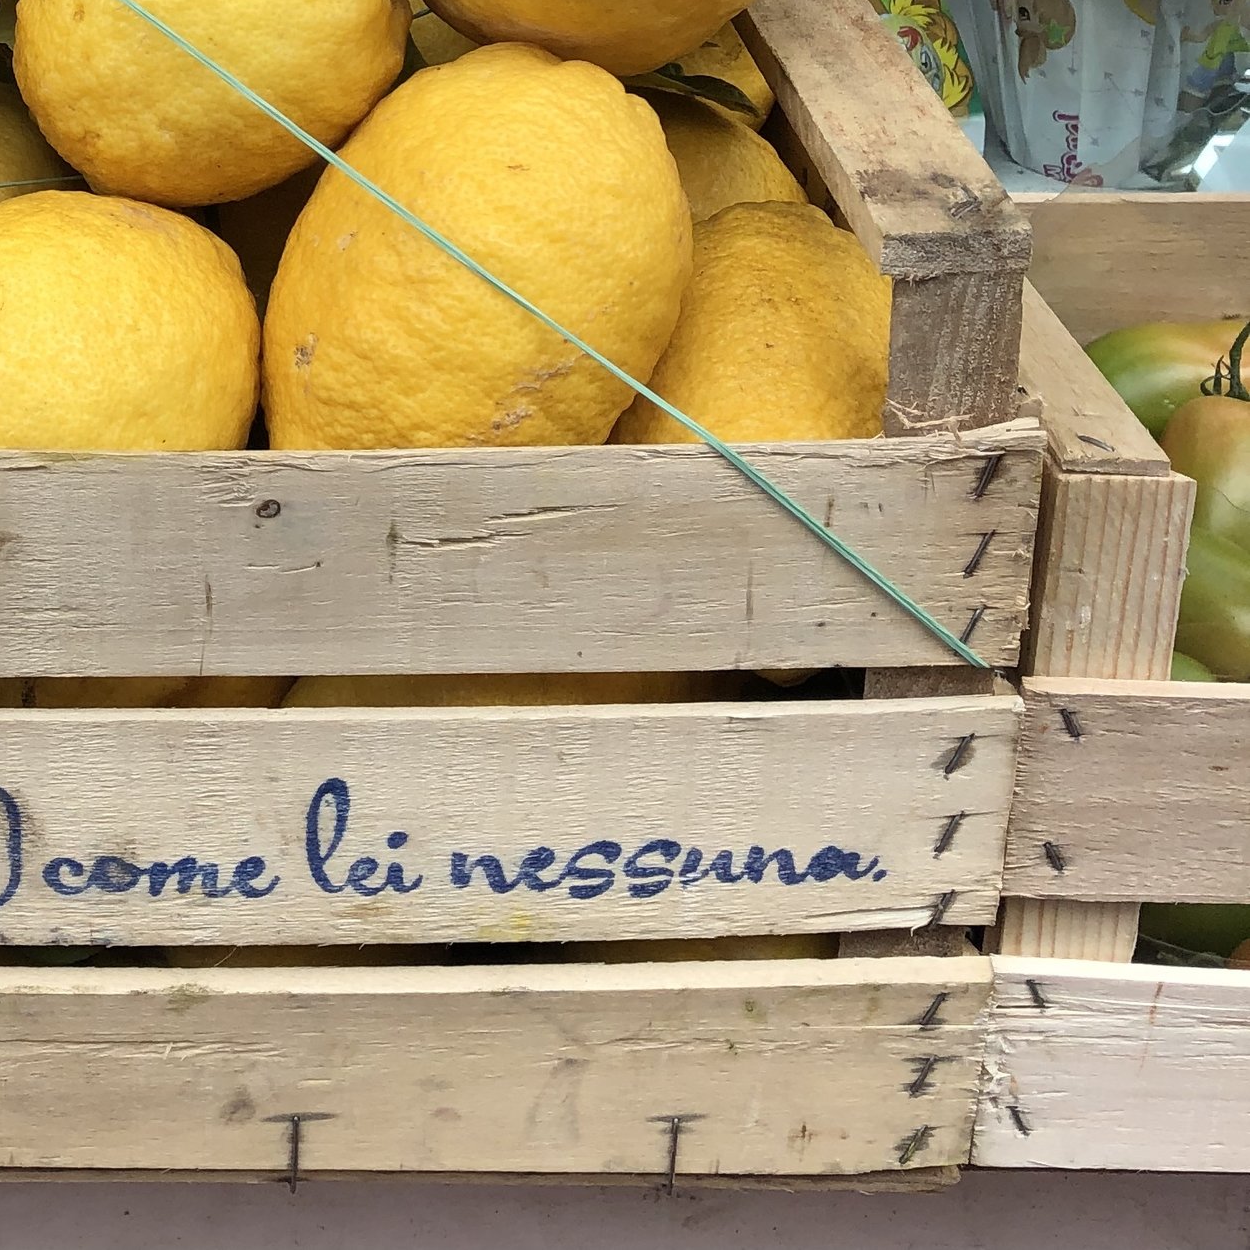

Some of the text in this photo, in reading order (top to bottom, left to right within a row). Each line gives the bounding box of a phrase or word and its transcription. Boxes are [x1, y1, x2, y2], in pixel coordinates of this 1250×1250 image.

[42, 853, 280, 898] come
[305, 777, 424, 895] lei
[449, 837, 887, 900] nessuna.
